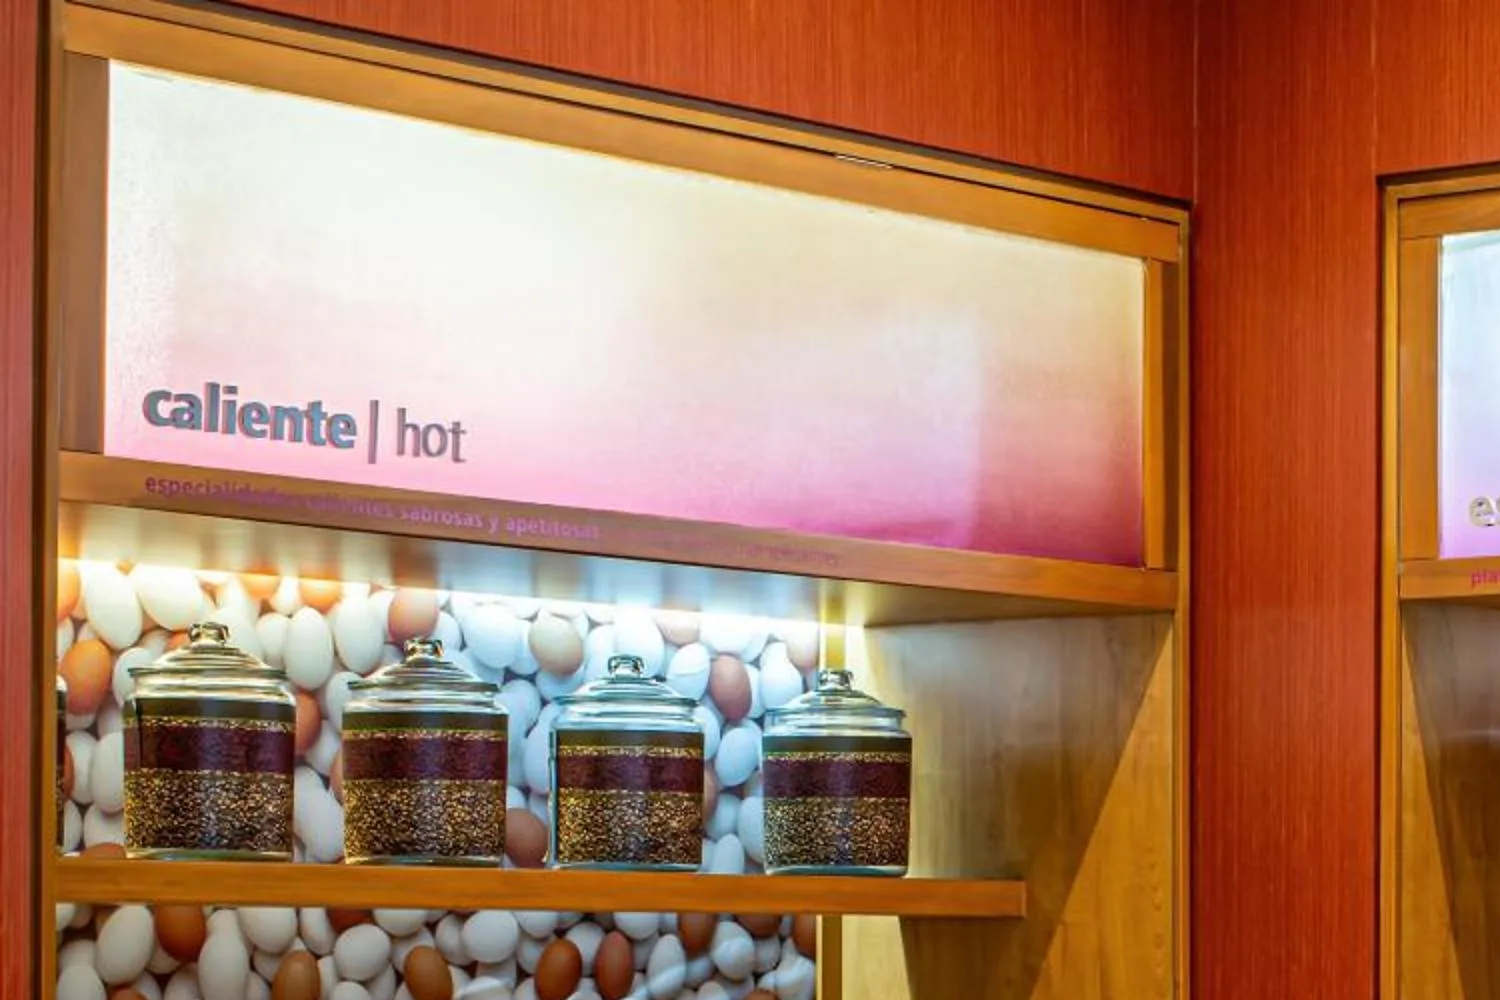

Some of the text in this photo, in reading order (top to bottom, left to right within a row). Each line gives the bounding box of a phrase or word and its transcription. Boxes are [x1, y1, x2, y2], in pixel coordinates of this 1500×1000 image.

[142, 382, 358, 449] caliente
[396, 407, 466, 463] hot
[400, 506, 483, 528] sabrosas
[488, 516, 500, 534] y
